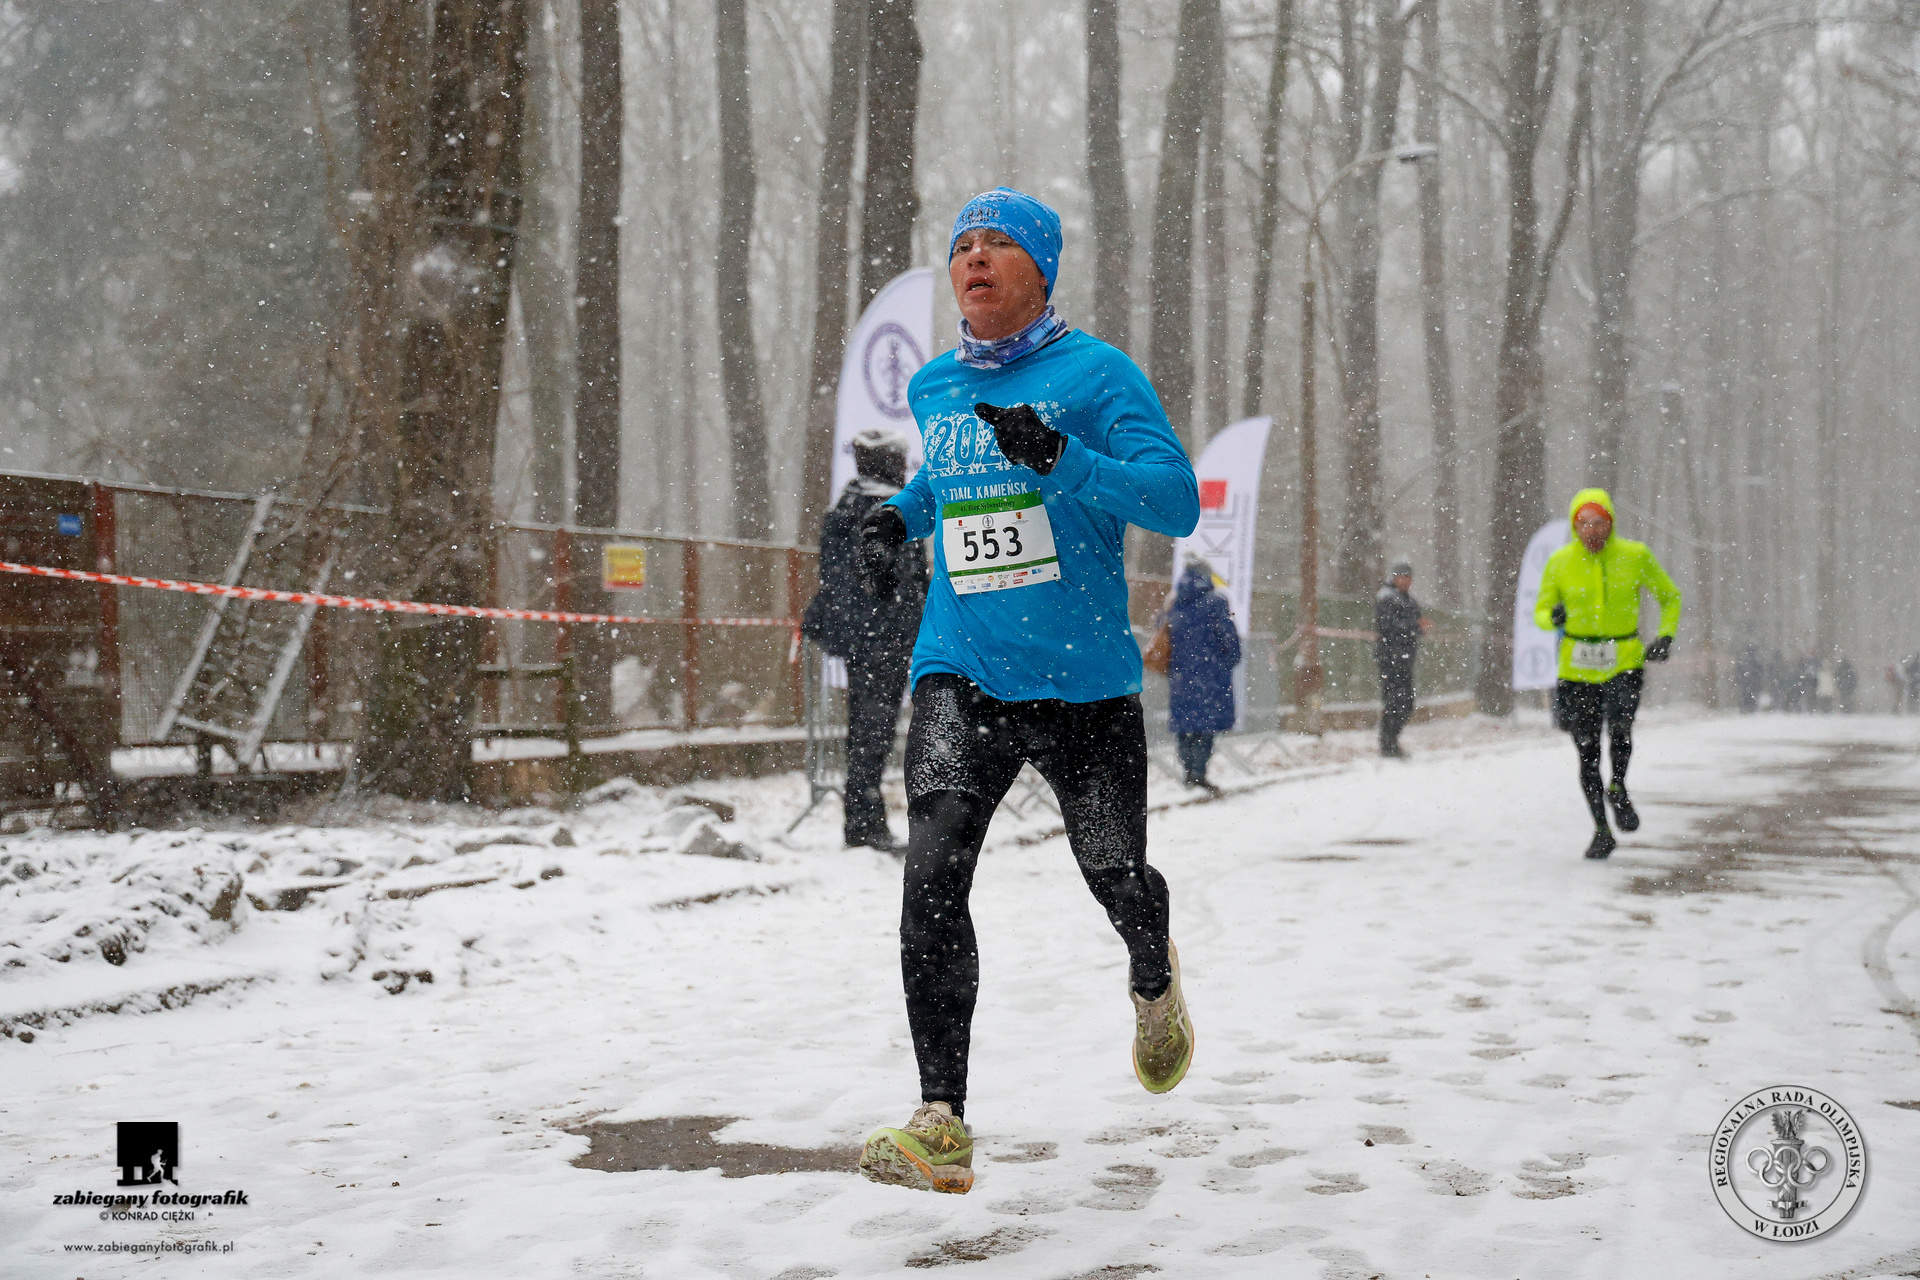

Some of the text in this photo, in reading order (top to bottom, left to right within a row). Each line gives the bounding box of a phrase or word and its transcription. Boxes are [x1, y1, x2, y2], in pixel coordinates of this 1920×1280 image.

[949, 486, 973, 501] TRAIL
[976, 480, 1028, 499] KAMIEŃSK
[963, 526, 1023, 562] 553
